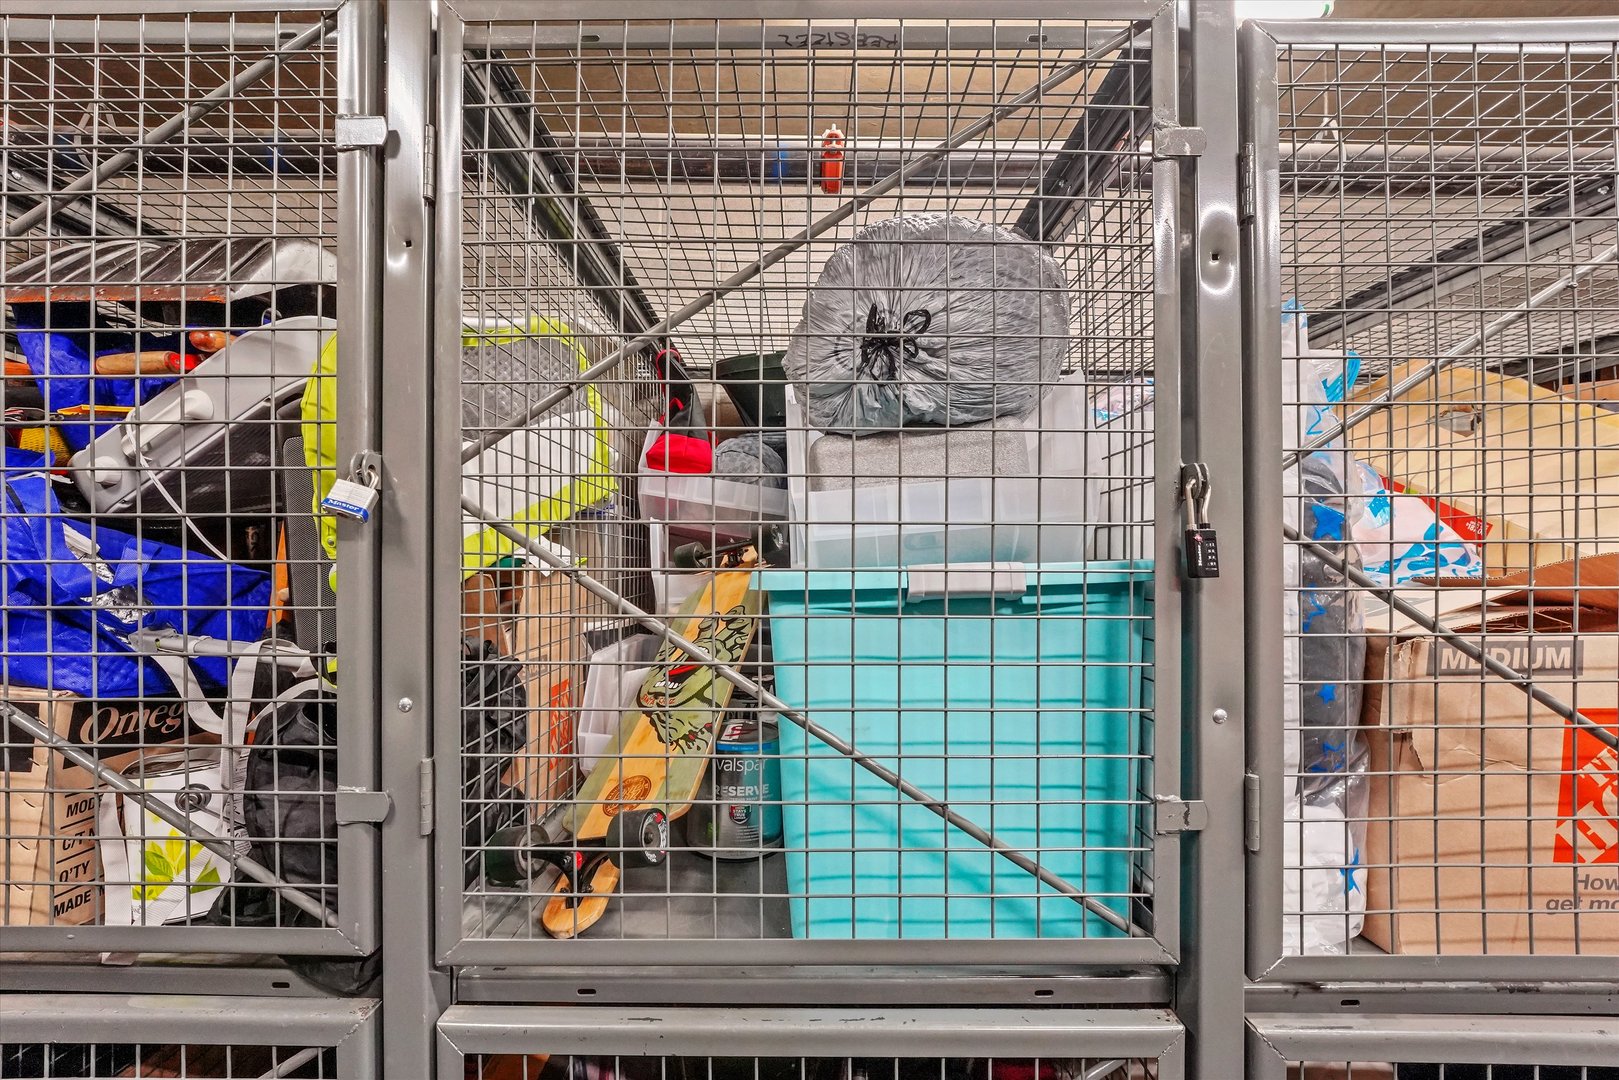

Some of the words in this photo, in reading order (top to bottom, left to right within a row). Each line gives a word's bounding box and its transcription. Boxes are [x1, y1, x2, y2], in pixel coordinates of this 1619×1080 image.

[328, 499, 359, 511] Master
[79, 702, 185, 744] Omeg
[54, 889, 92, 918] MADE
